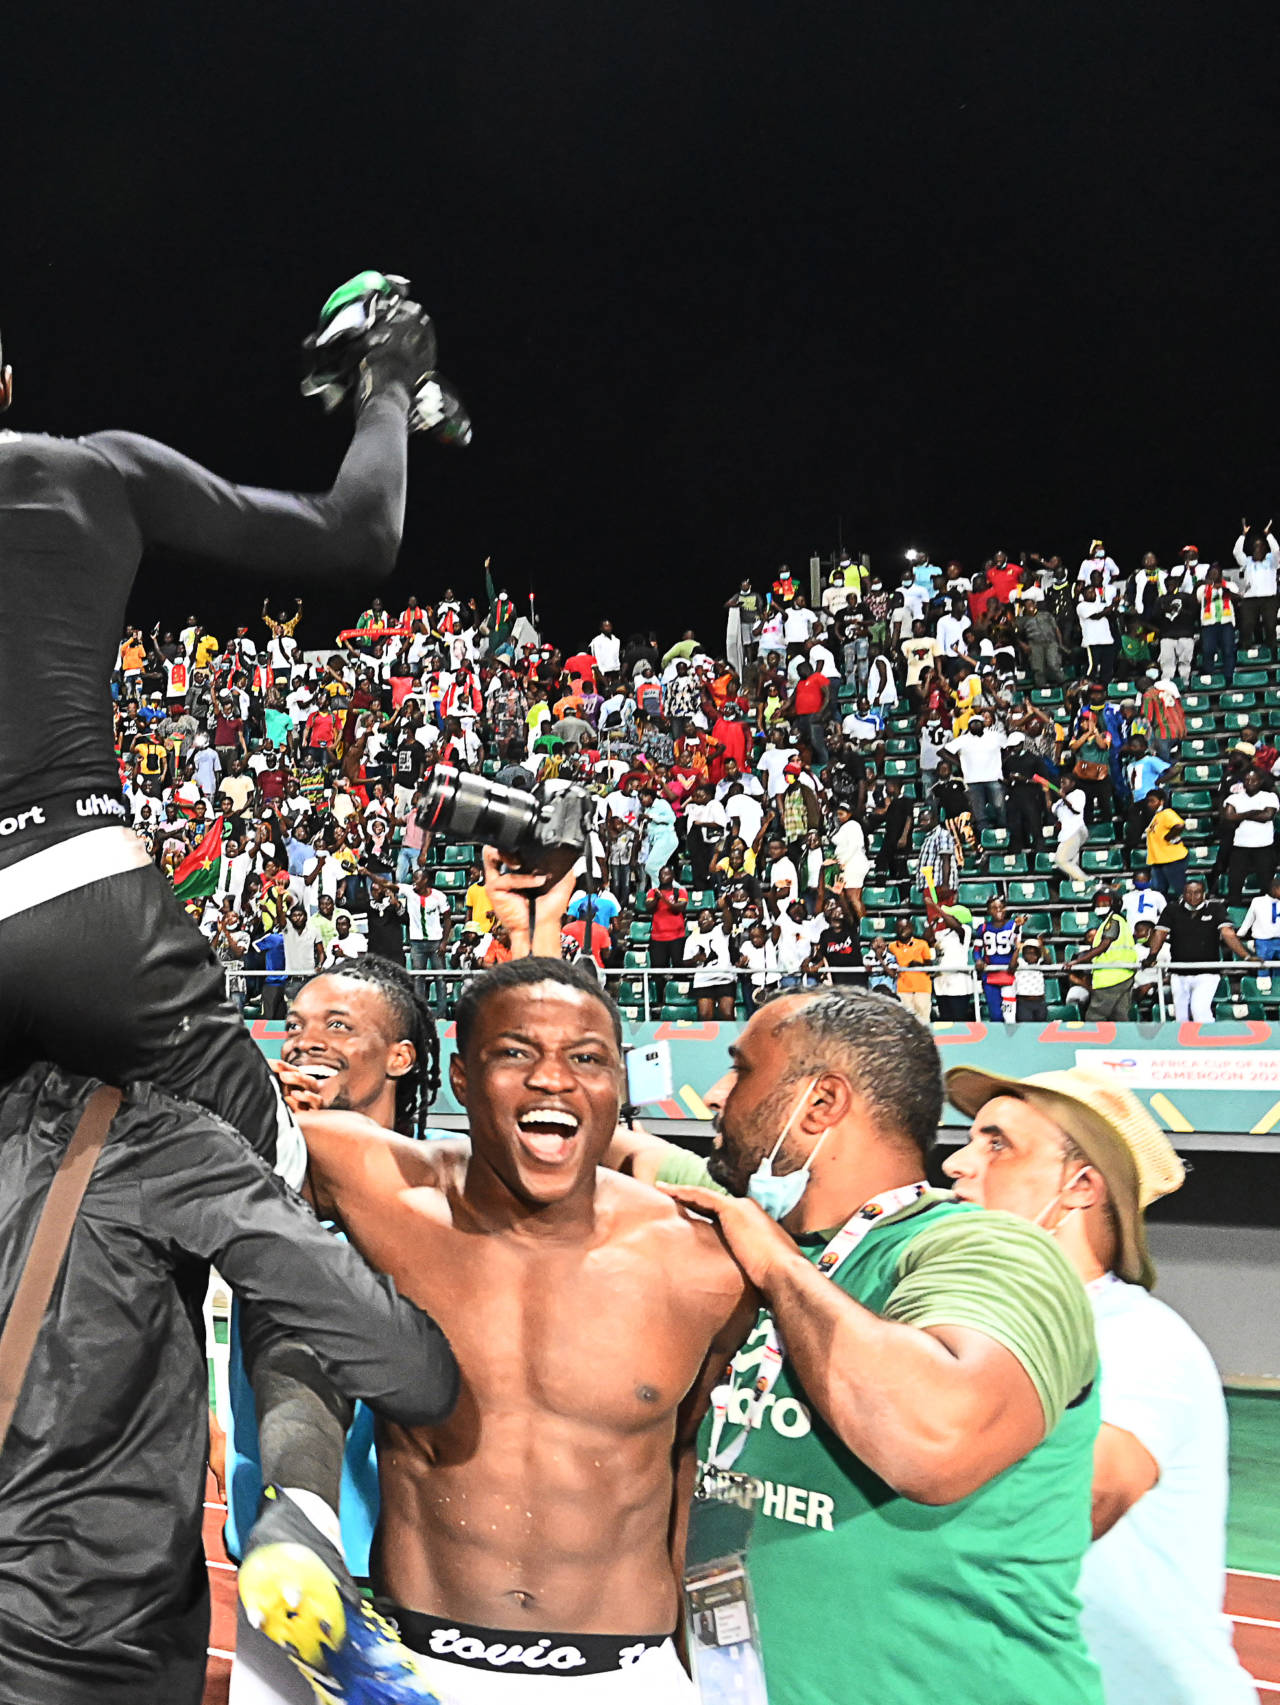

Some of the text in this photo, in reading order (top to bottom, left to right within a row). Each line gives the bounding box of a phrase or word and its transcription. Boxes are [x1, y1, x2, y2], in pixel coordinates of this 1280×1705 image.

[1151, 1059, 1280, 1068] AFRICA CUP OF NA
[1151, 1071, 1244, 1081] CAMEROON
[429, 1628, 586, 1670] tovio
